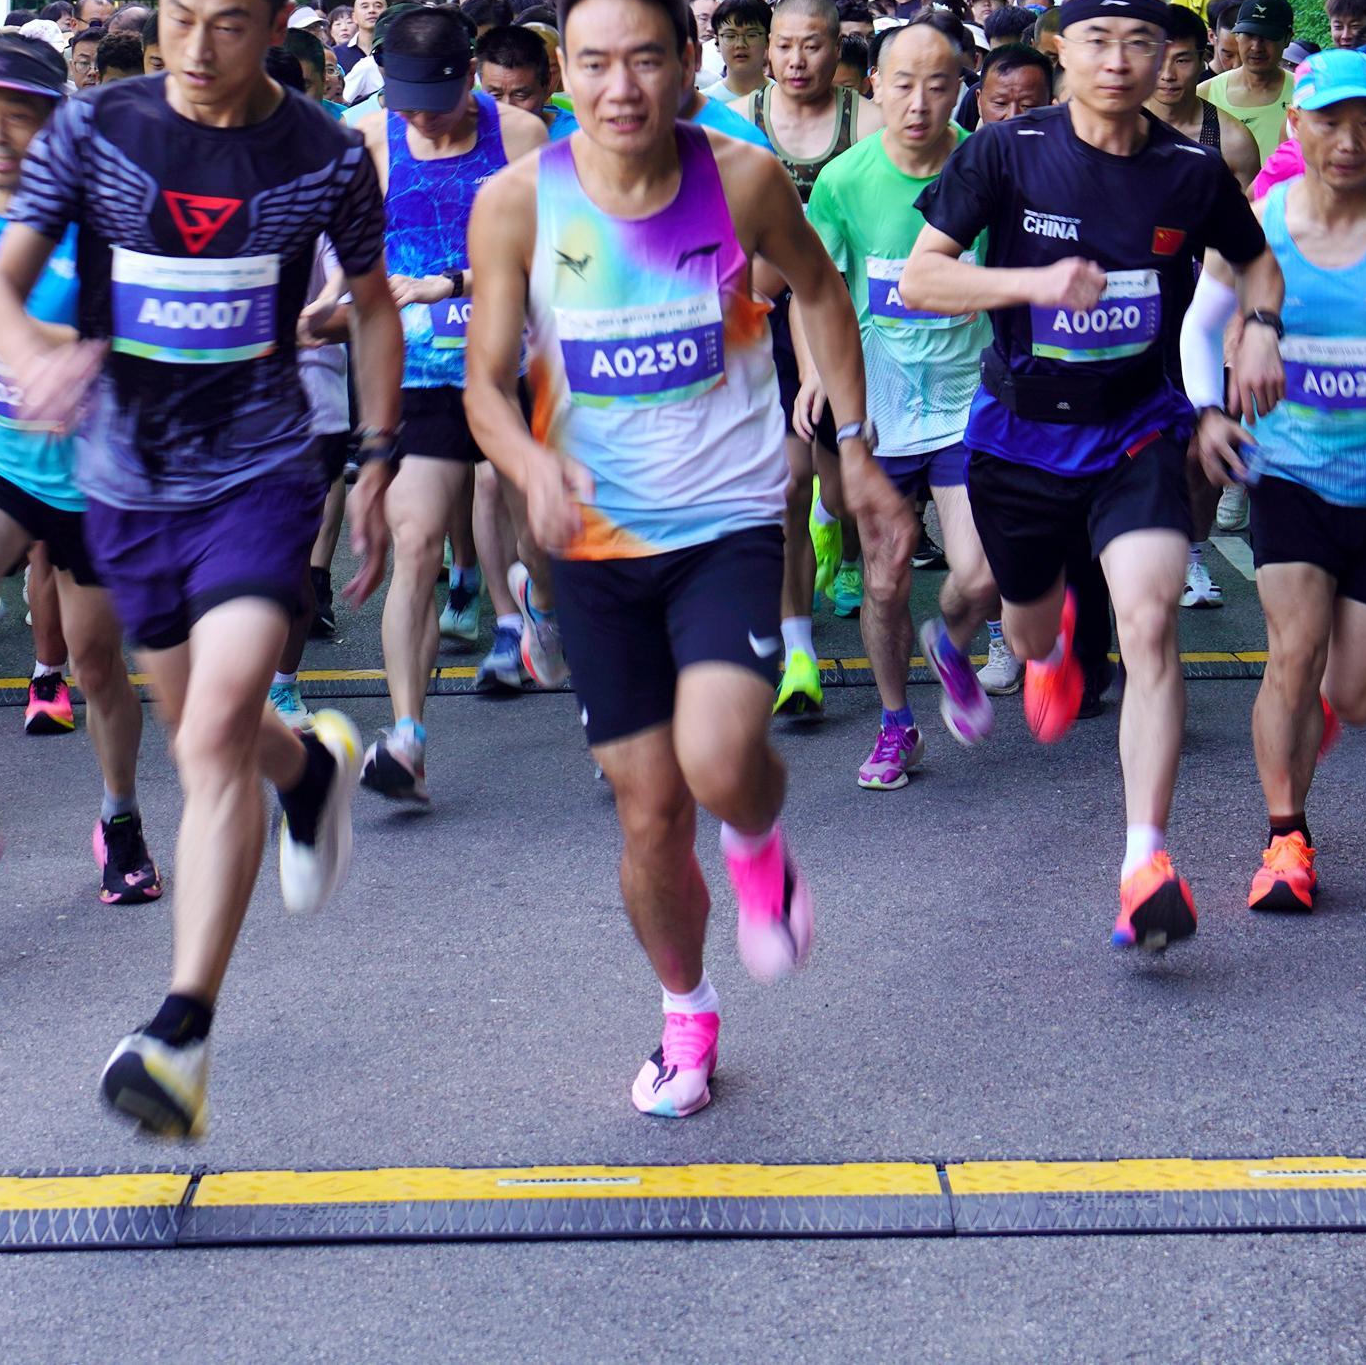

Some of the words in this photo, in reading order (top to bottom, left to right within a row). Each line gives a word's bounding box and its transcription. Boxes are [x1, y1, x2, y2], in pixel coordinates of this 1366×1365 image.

[1023, 215, 1079, 242] CHINA
[137, 298, 252, 329] A0007
[1053, 305, 1141, 335] A0020
[590, 338, 698, 379] A0230
